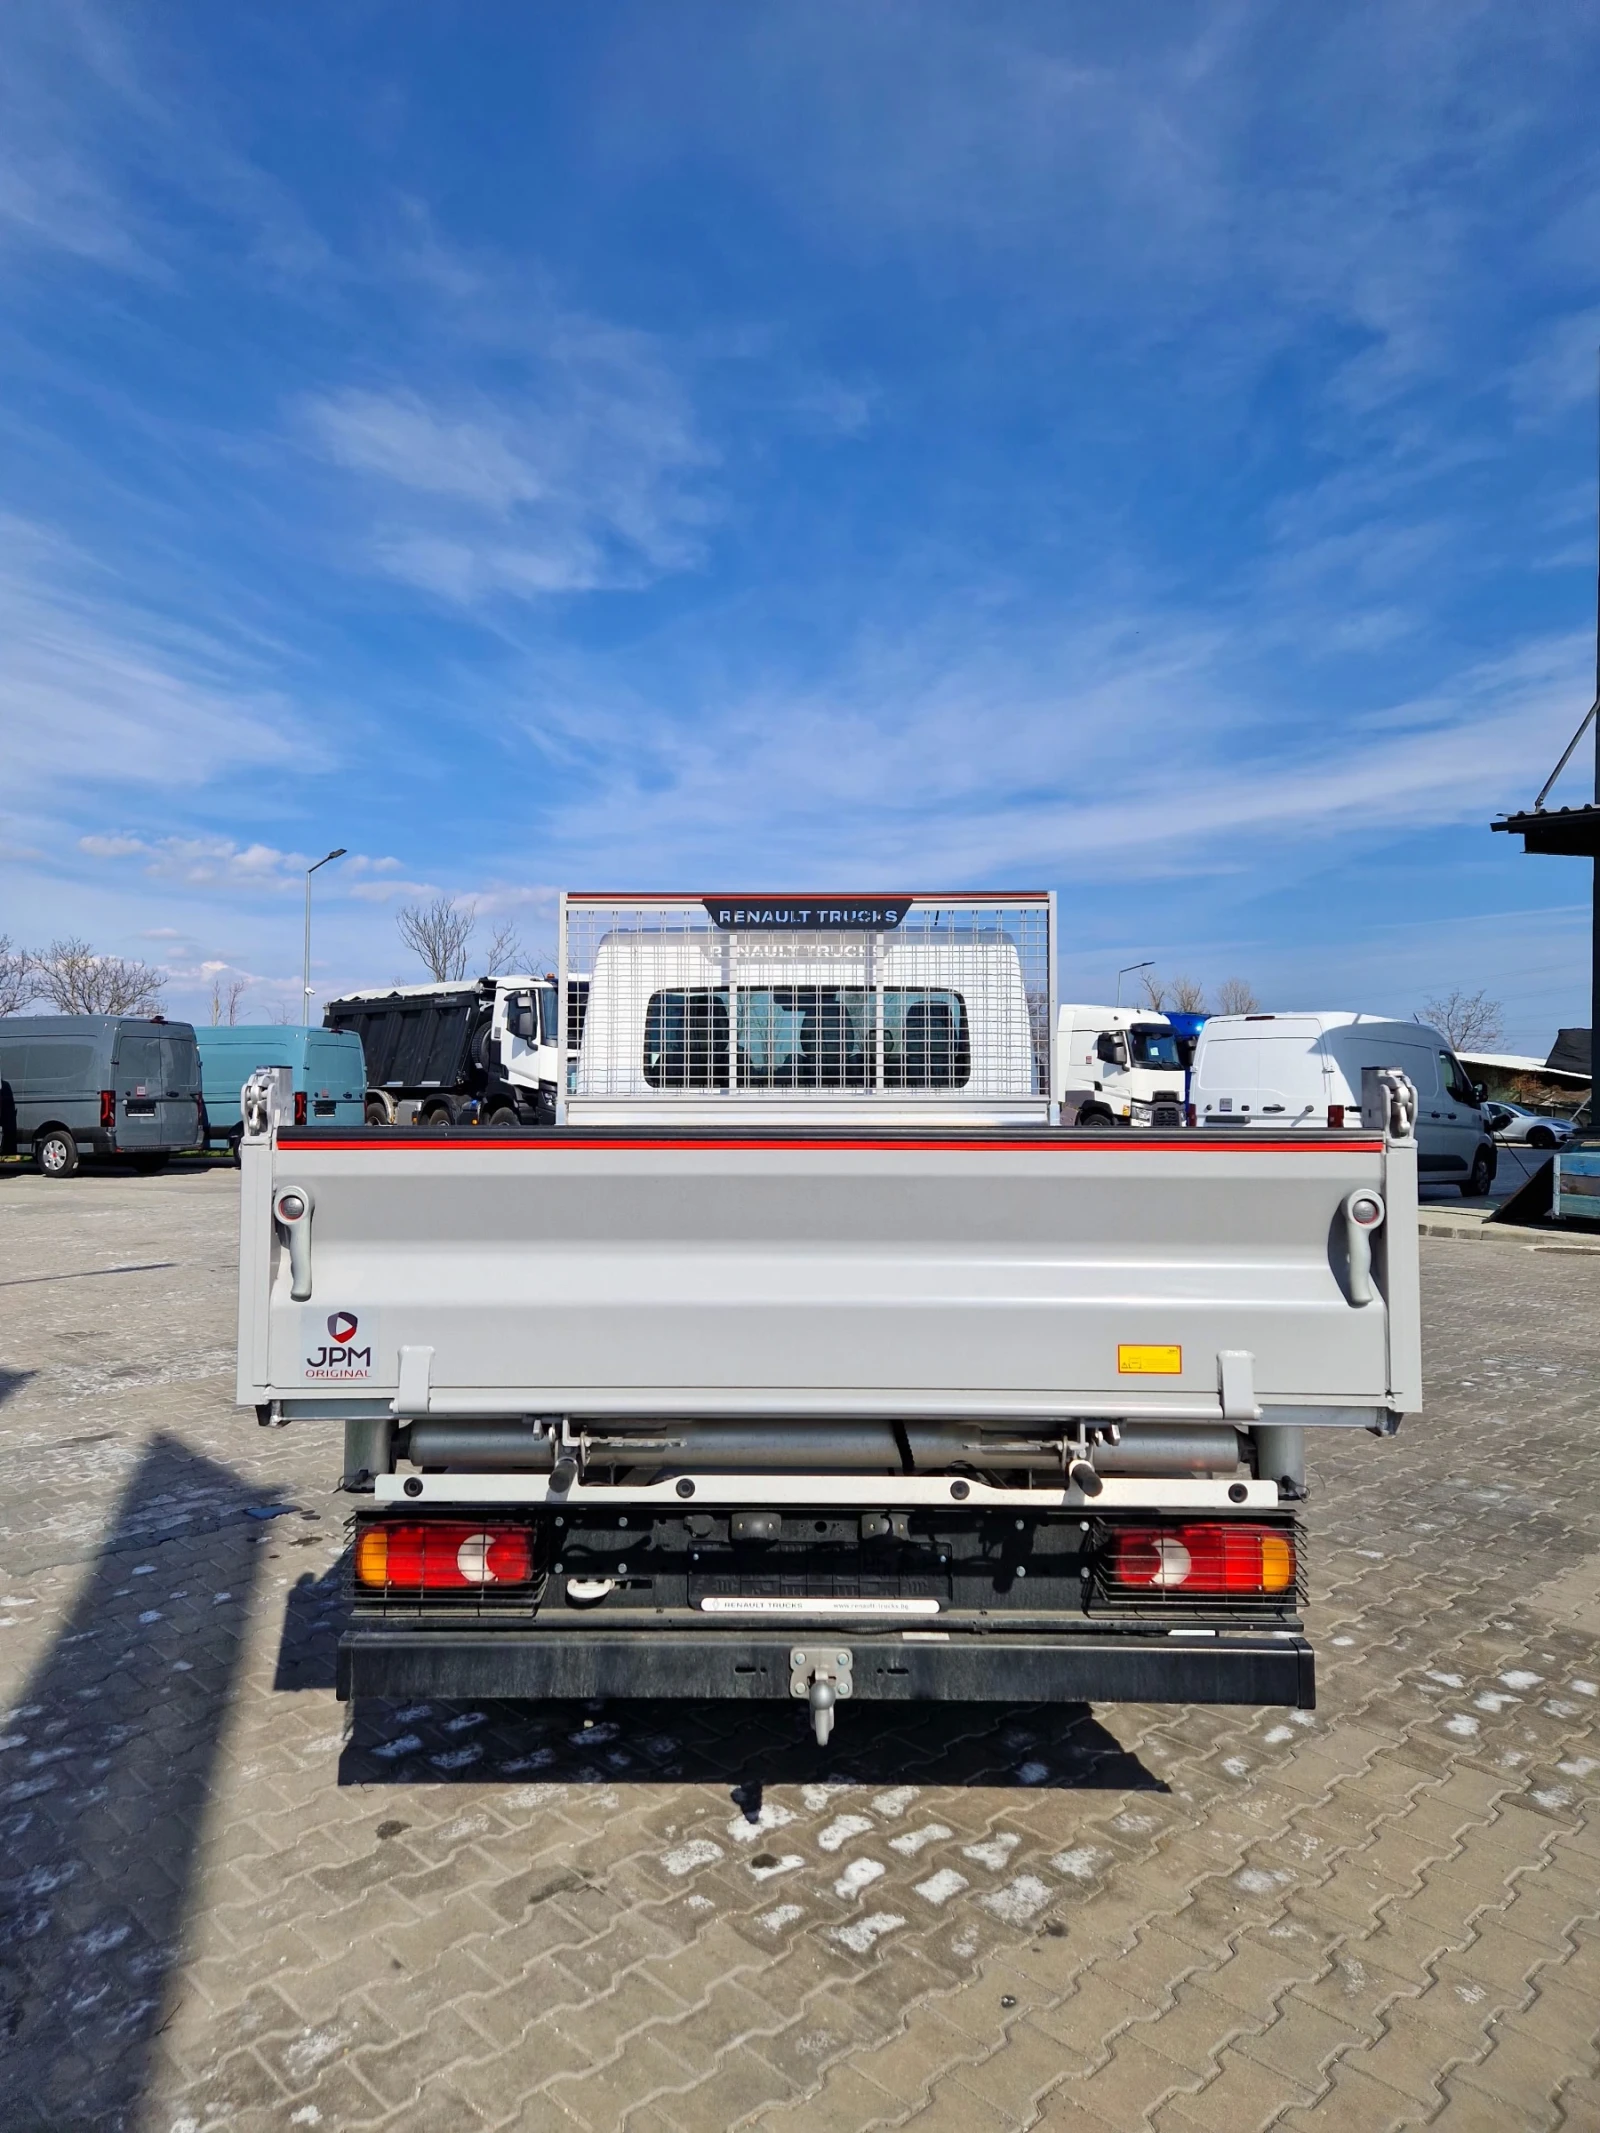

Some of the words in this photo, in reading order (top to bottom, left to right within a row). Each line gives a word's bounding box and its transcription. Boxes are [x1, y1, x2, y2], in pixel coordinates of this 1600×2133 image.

[720, 910, 811, 923] RENAULT
[817, 910, 898, 923] TRUCKS
[709, 945, 799, 958] RNAULT
[306, 1346, 371, 1368] JPM
[305, 1369, 372, 1378] ORIGINAL
